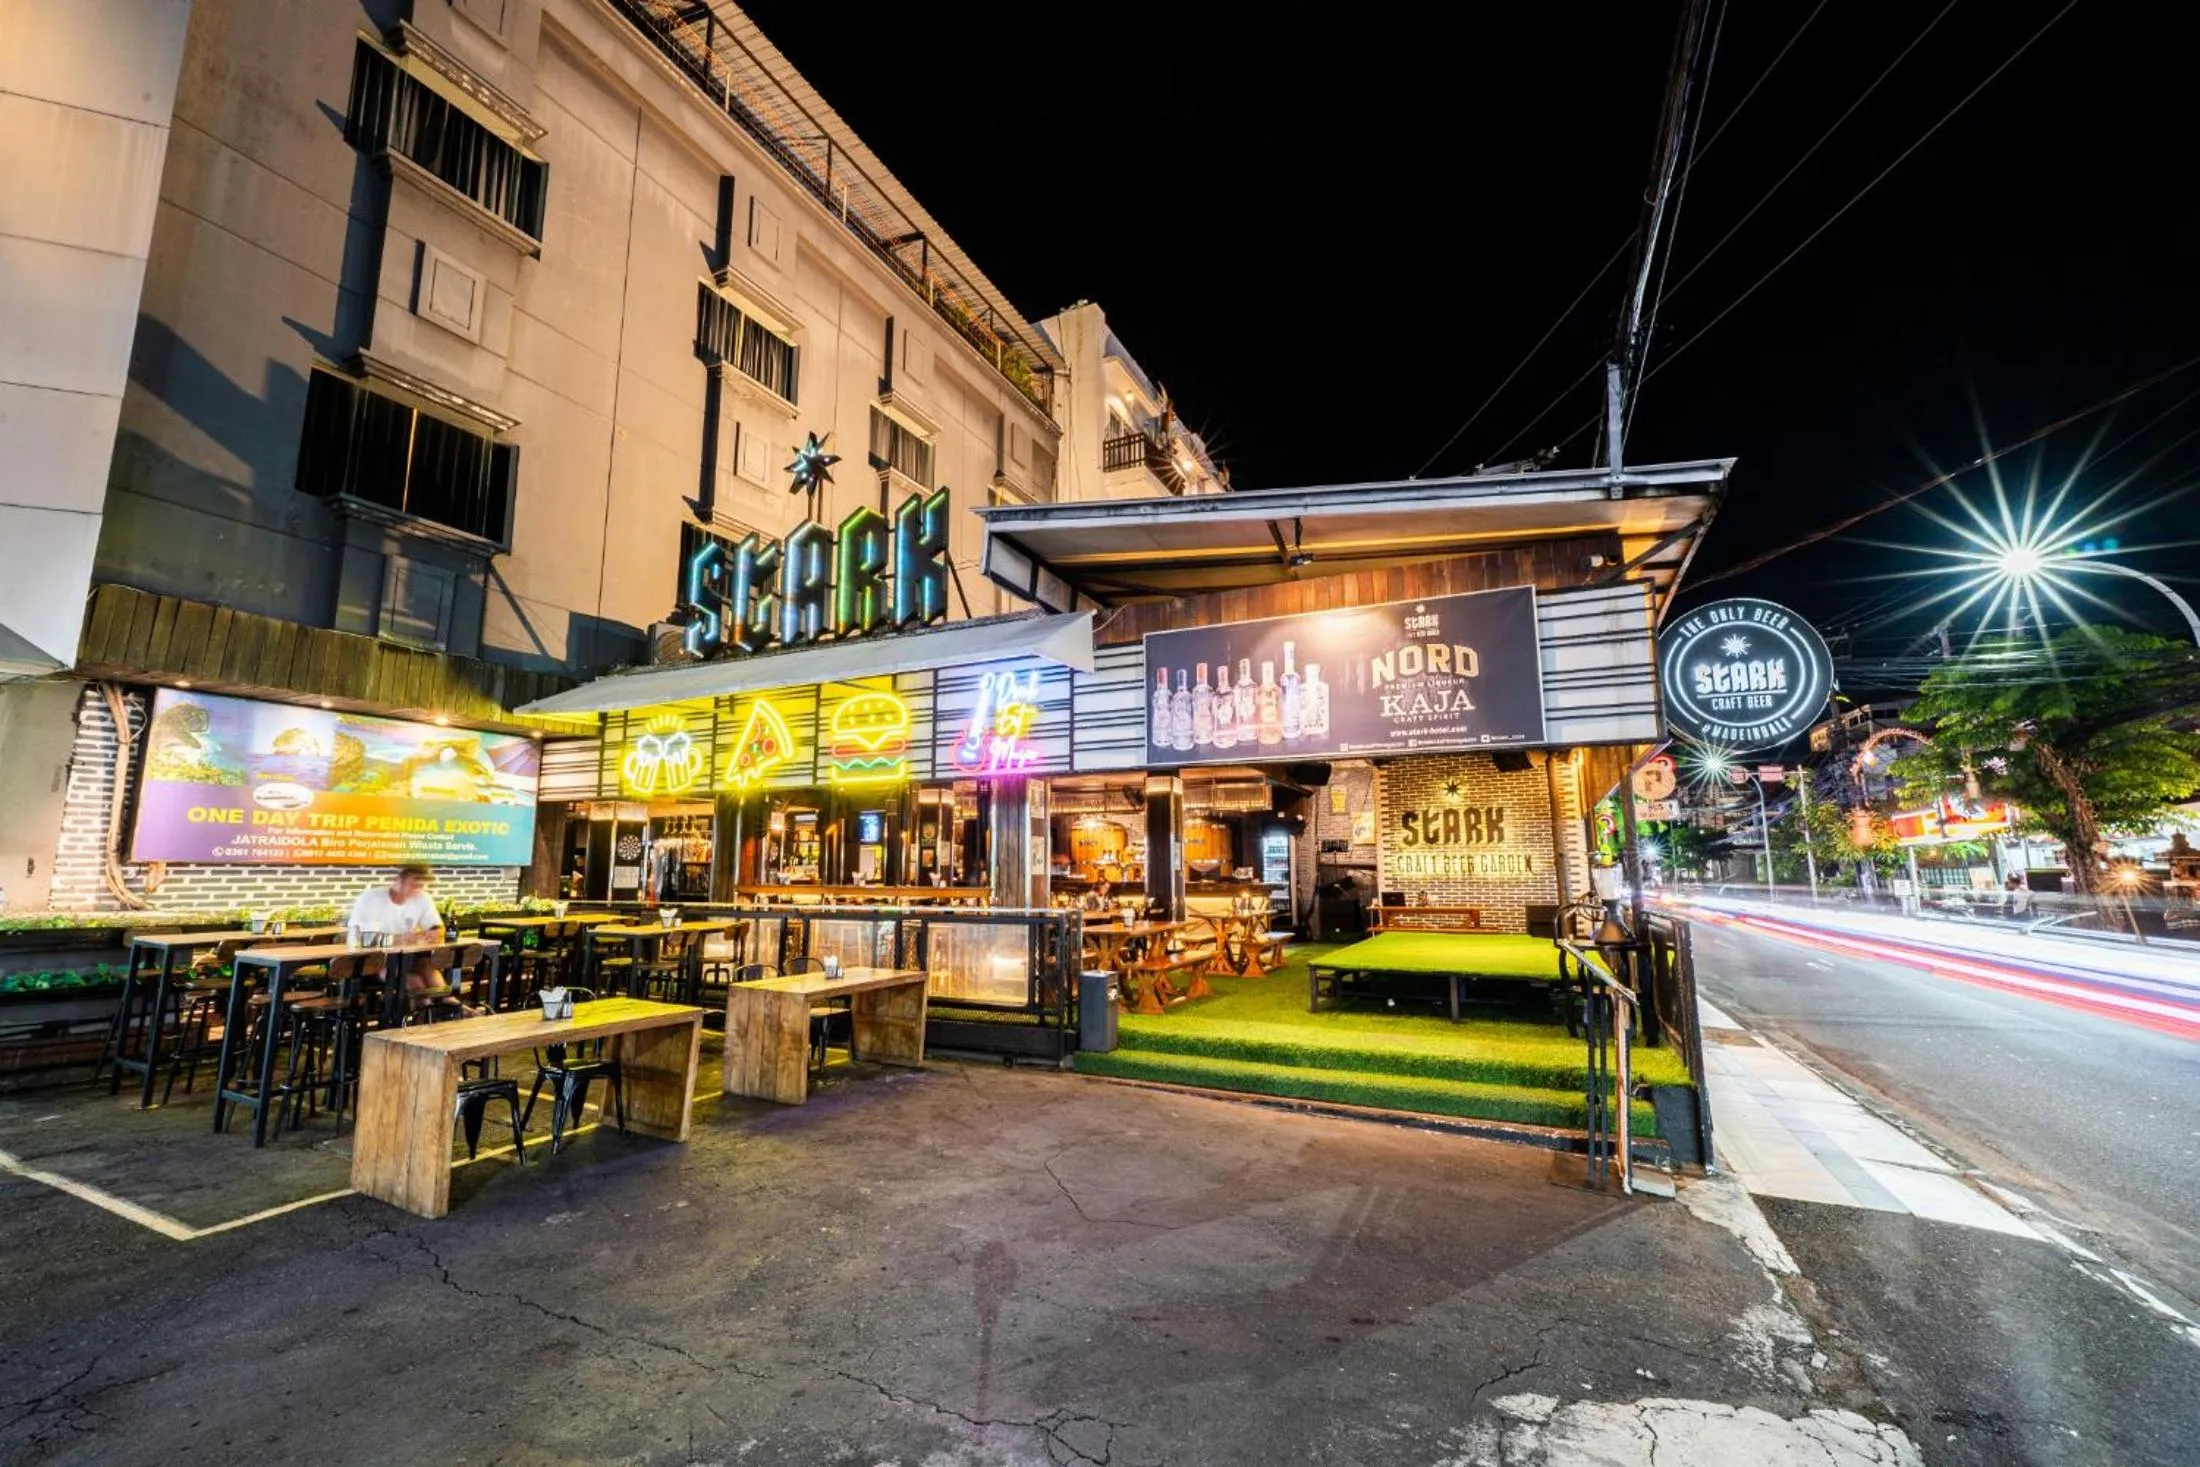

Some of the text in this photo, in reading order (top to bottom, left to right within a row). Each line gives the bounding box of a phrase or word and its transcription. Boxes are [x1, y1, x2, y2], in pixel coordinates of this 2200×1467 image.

[1679, 606, 1790, 638] THE ONLY BEER
[1371, 643, 1480, 689] NORD
[1379, 689, 1476, 717] KAJA
[1712, 695, 1773, 711] CRAFT BEER
[1393, 712, 1461, 723] CRAFT SPIRIT
[1701, 716, 1793, 741] #MADEINBALI
[188, 807, 510, 834] ONE DAY TRIP PENIDA EXOTIC
[321, 836, 345, 847] Biro
[1397, 854, 1532, 875] CRAFT BEER GARDEN
